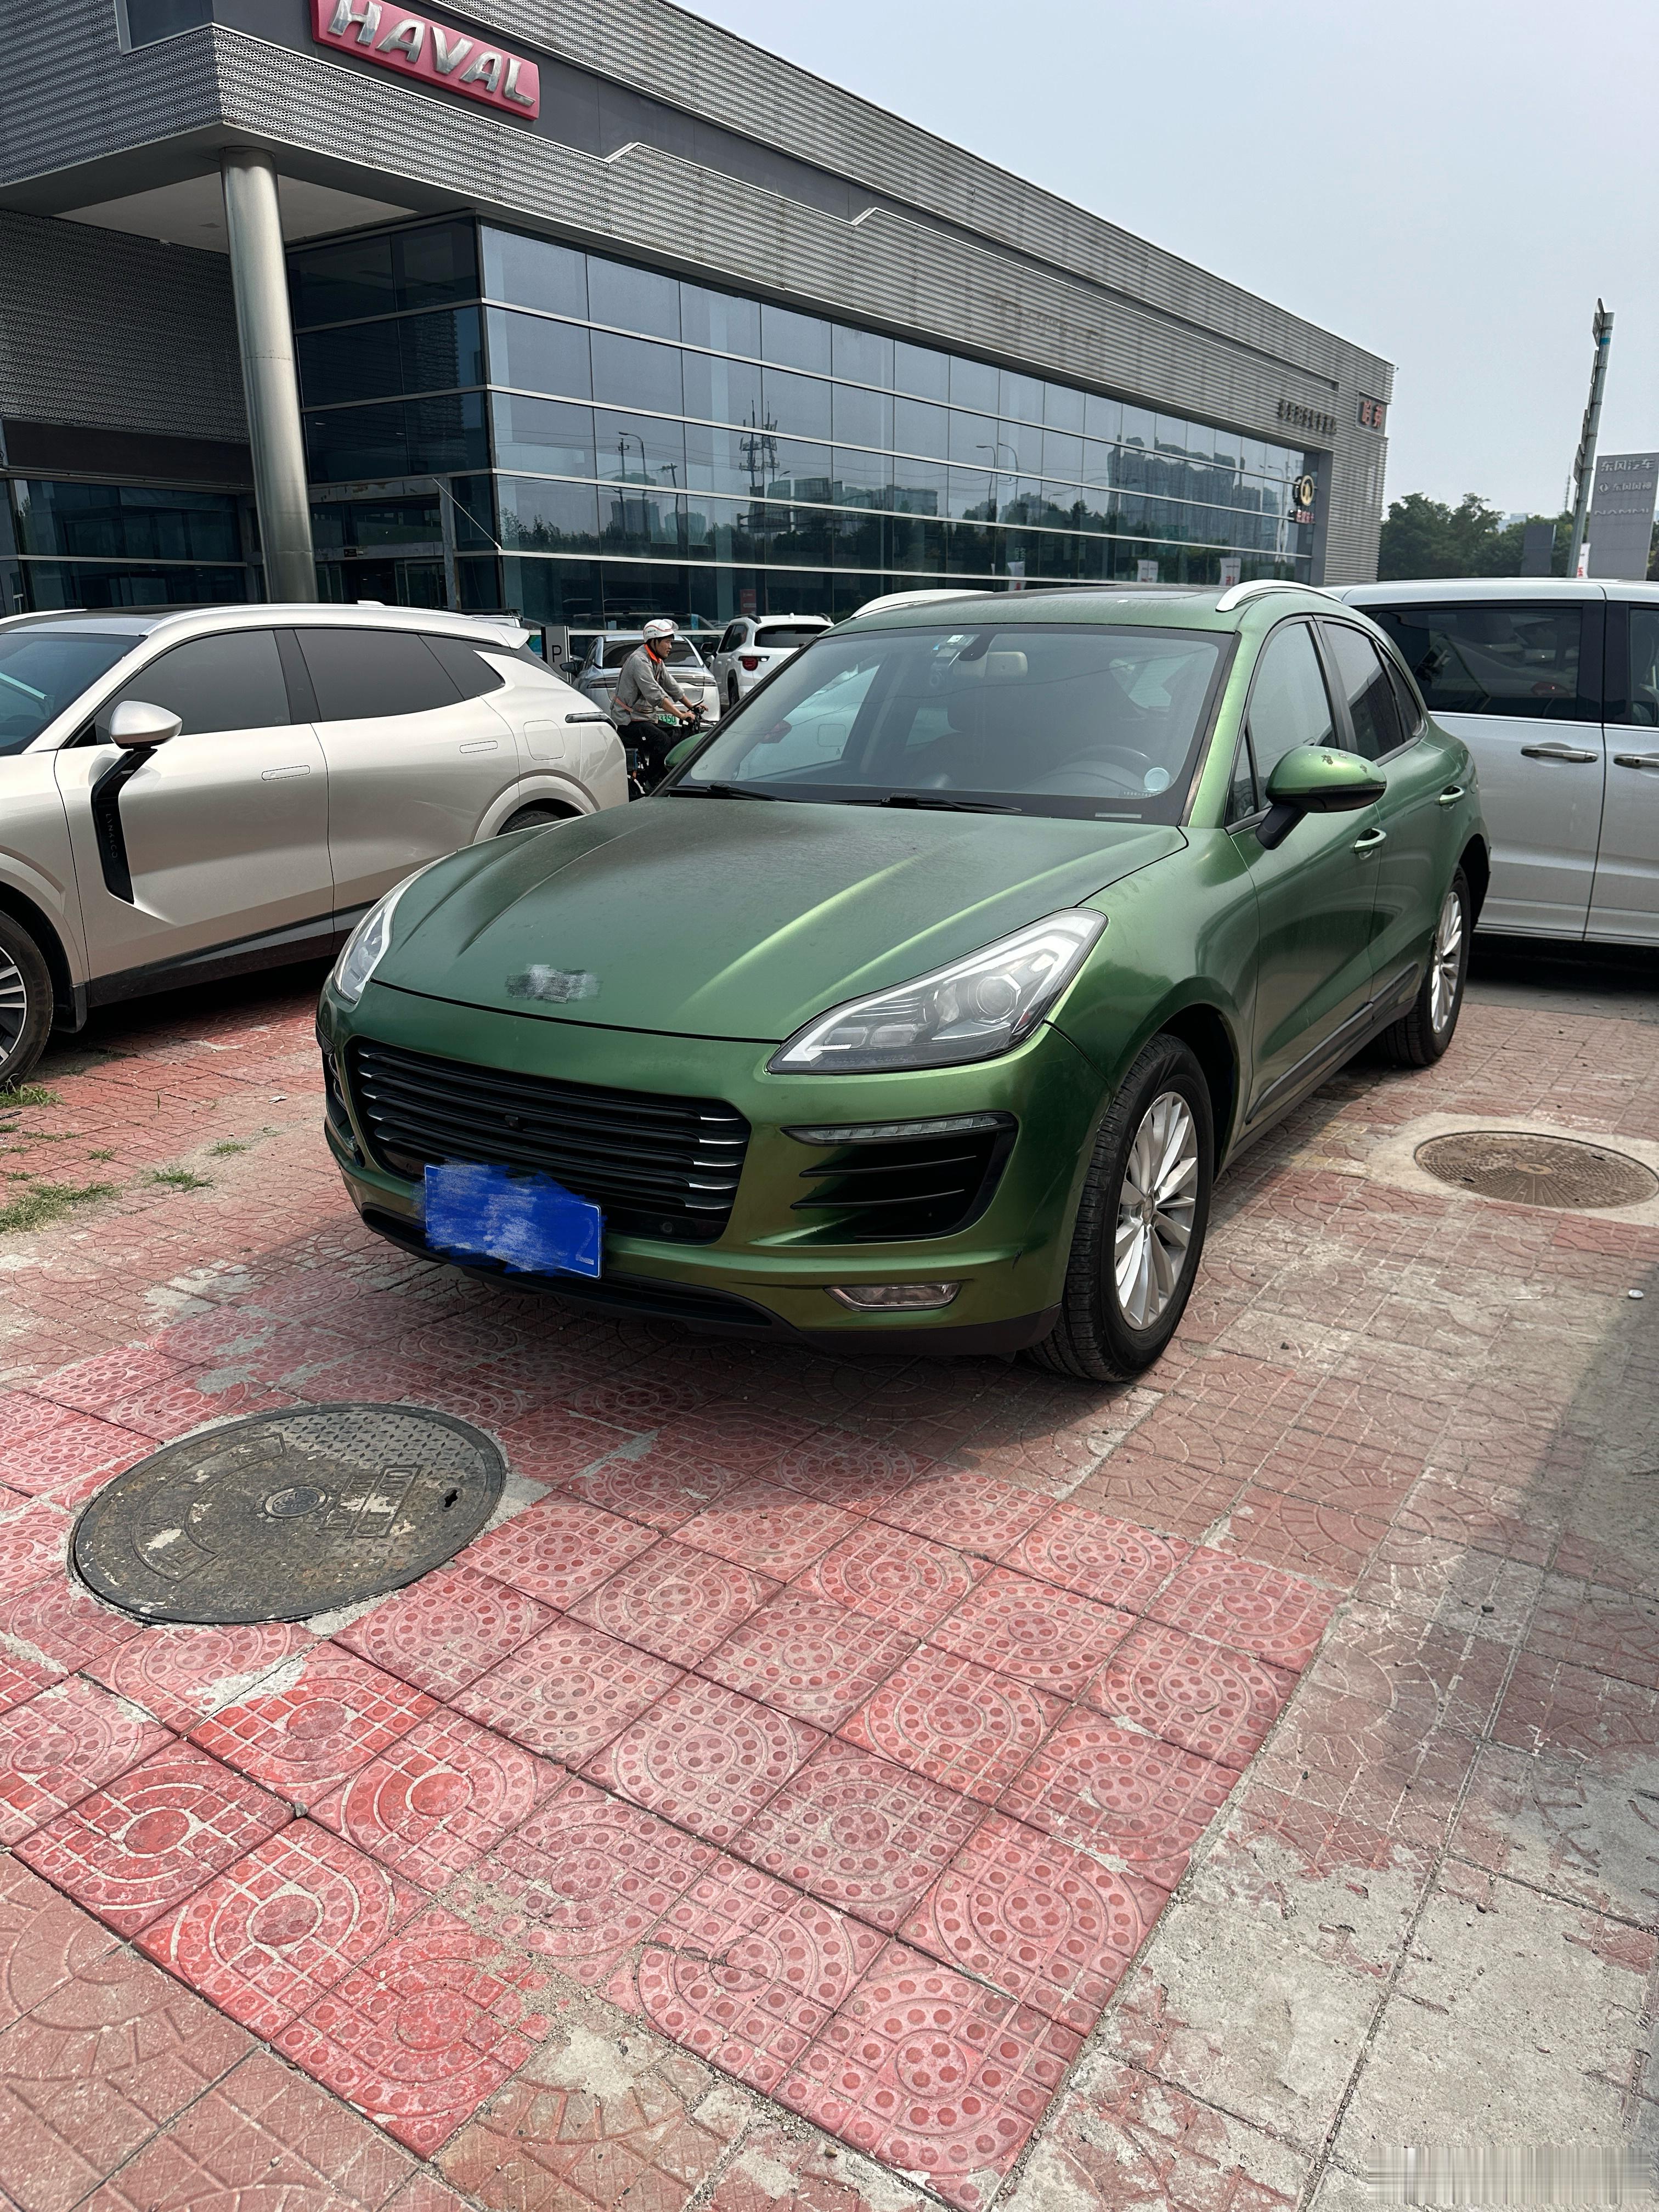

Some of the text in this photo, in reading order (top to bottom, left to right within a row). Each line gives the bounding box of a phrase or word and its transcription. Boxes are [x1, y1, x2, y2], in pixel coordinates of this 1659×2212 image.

[327, 0, 536, 106] HAVAL
[1600, 459, 1655, 471] 东风汽车
[551, 645, 562, 663] P
